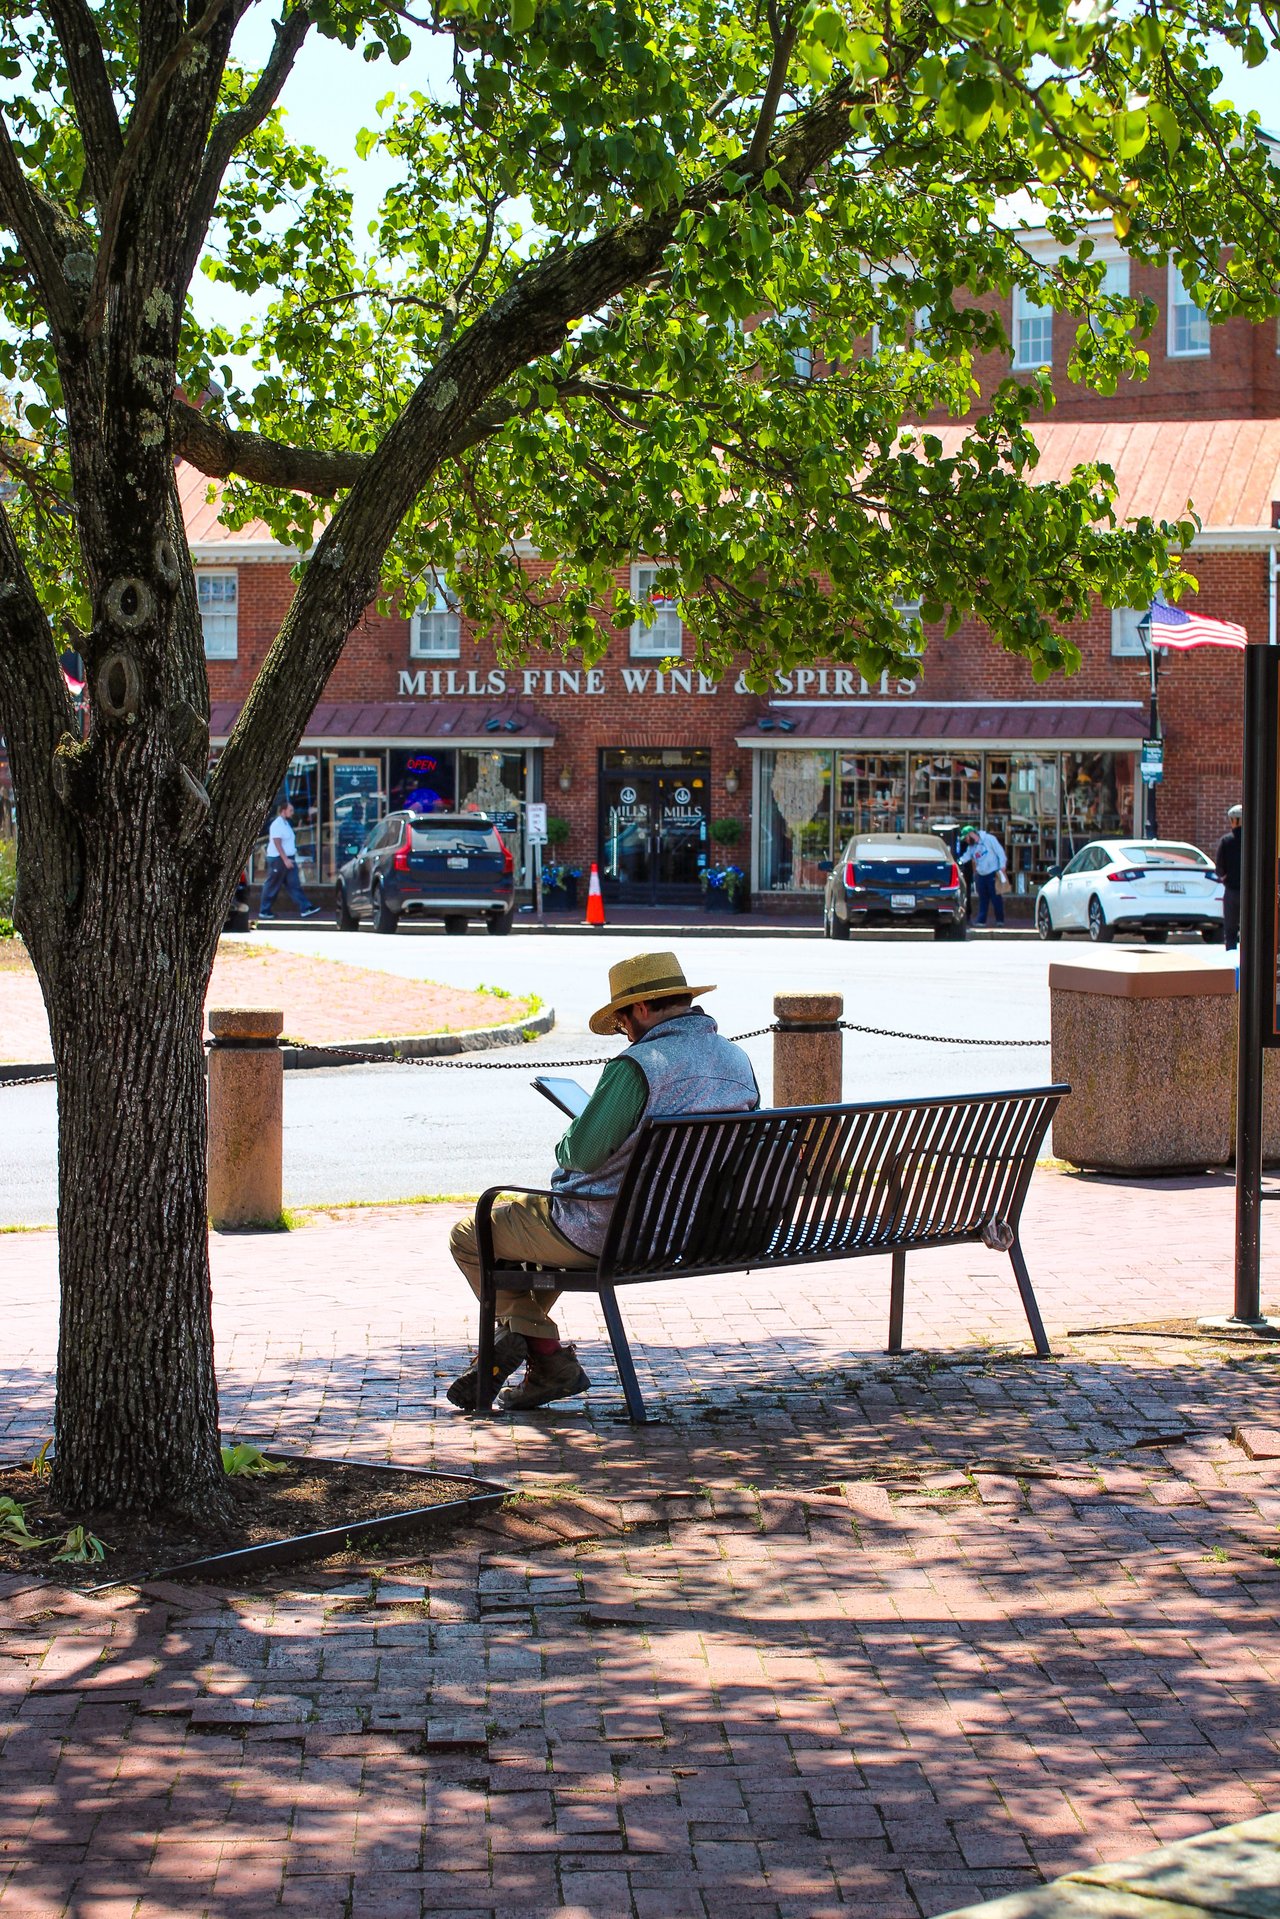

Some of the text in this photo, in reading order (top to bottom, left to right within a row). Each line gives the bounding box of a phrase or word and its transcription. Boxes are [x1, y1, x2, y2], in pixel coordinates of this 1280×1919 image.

[397, 670, 507, 695] MILLS
[522, 669, 606, 695] FINE
[621, 669, 718, 694] WINE
[407, 758, 437, 771] OPEN
[609, 805, 648, 816] MILLS
[664, 806, 703, 817] MILLS
